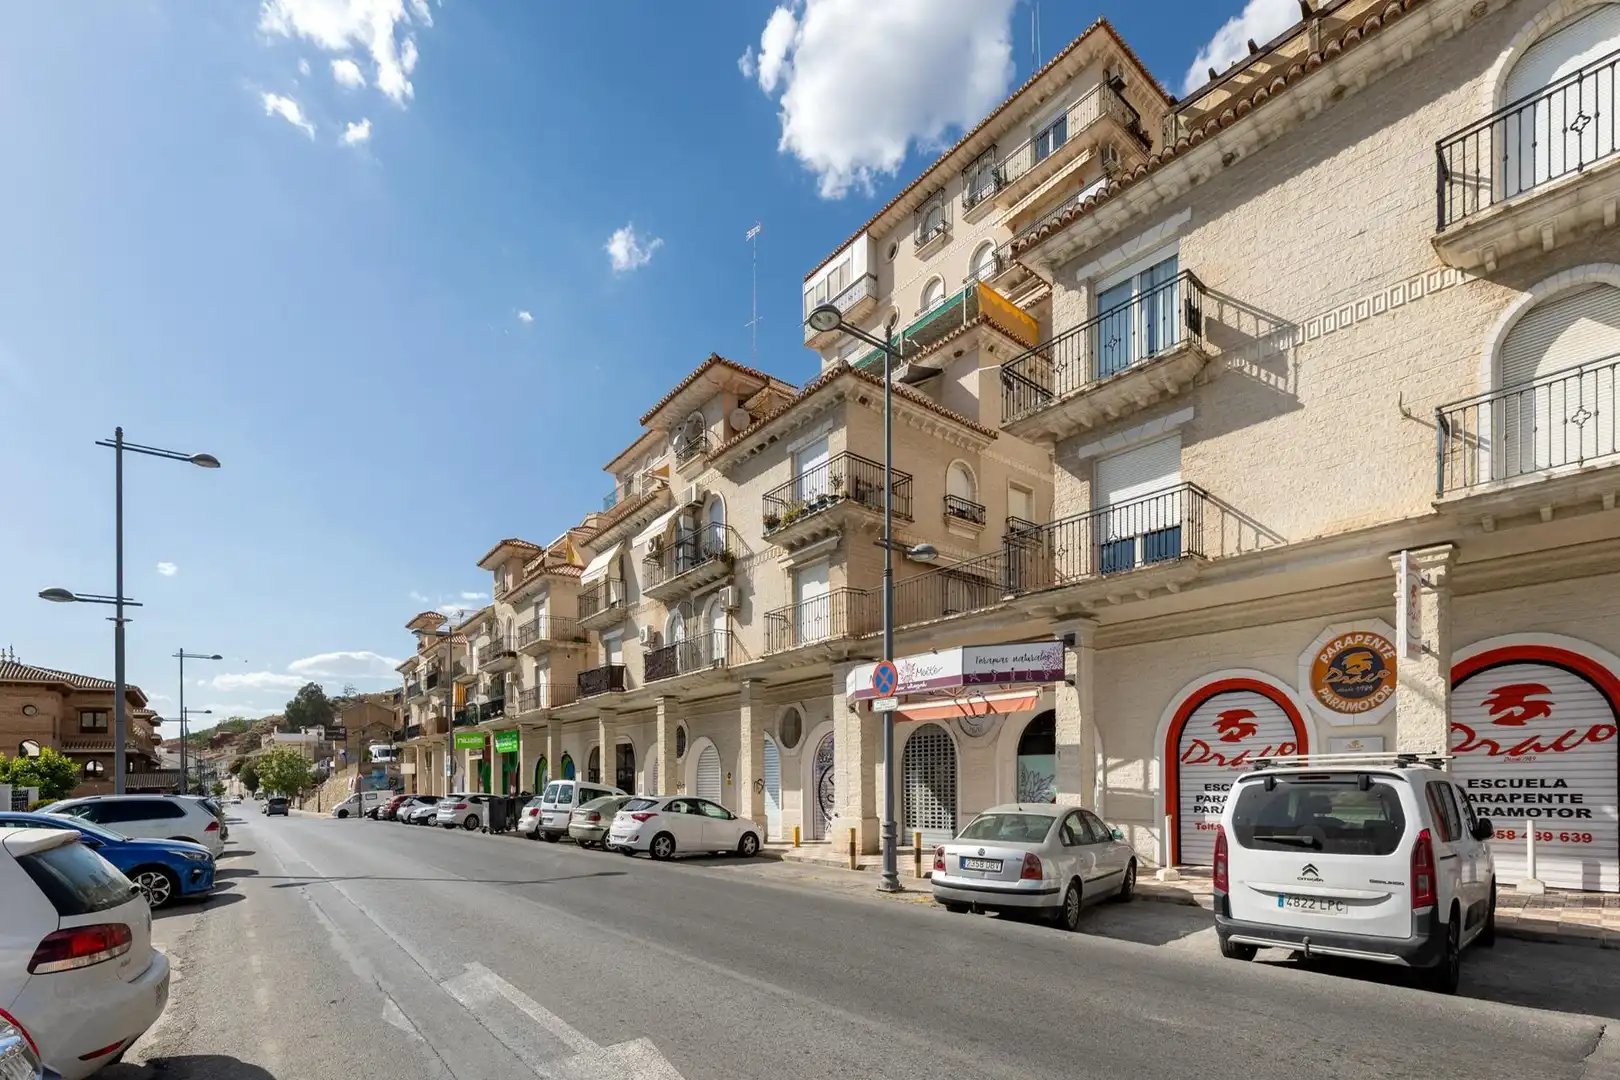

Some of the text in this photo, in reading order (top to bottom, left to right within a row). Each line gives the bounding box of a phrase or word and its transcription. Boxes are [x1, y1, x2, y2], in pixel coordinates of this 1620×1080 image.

[1320, 634, 1396, 664] PARAPENTE
[1322, 667, 1391, 684] Draco
[1318, 684, 1393, 712] PARAMOTOR
[1467, 779, 1568, 789] ESCUELA
[1466, 793, 1584, 804] ARAPENTE
[1559, 832, 1593, 844] 639
[1286, 896, 1344, 912] 4822 LPC
